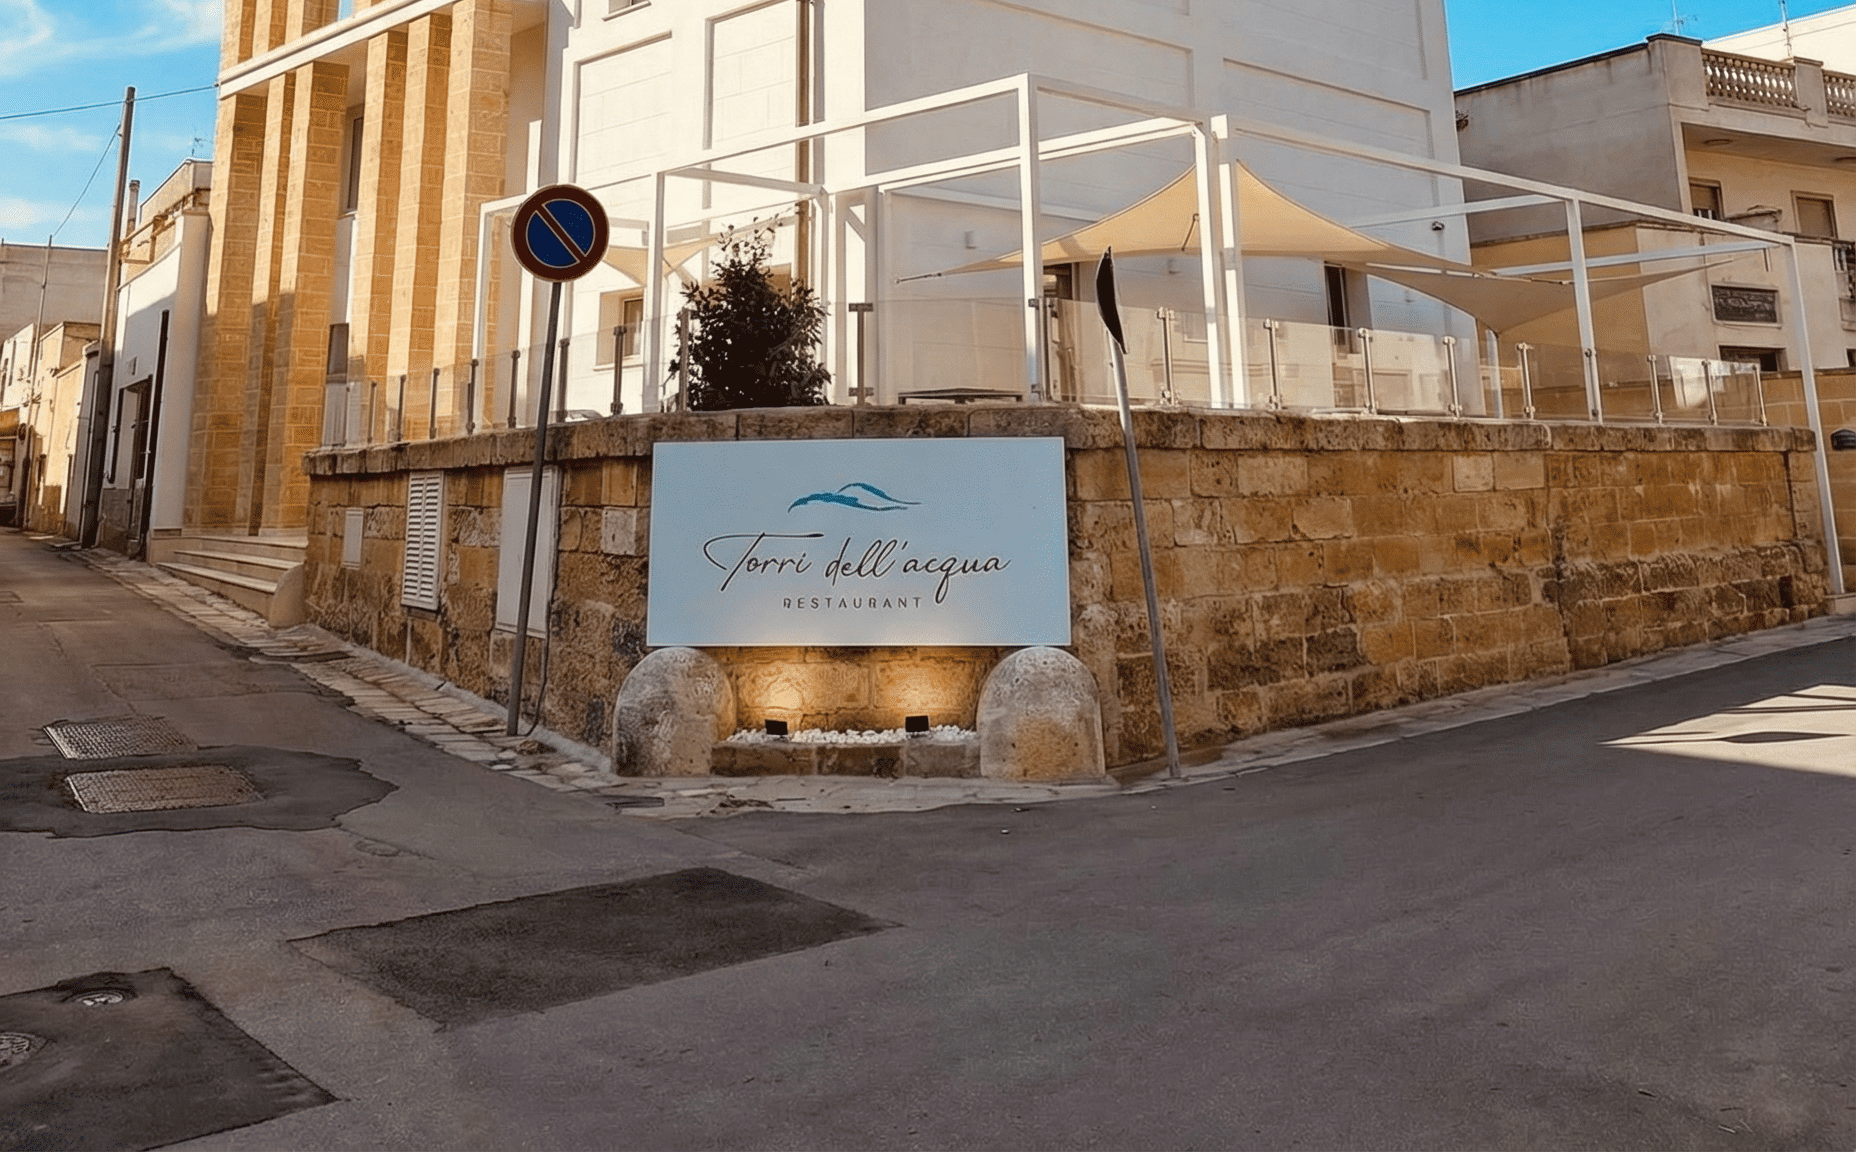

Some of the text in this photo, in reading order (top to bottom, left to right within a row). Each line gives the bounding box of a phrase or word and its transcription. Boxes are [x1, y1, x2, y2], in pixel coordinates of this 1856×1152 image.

[703, 532, 1011, 604] Torri dell'acqua
[783, 597, 922, 609] RESTAURANT
